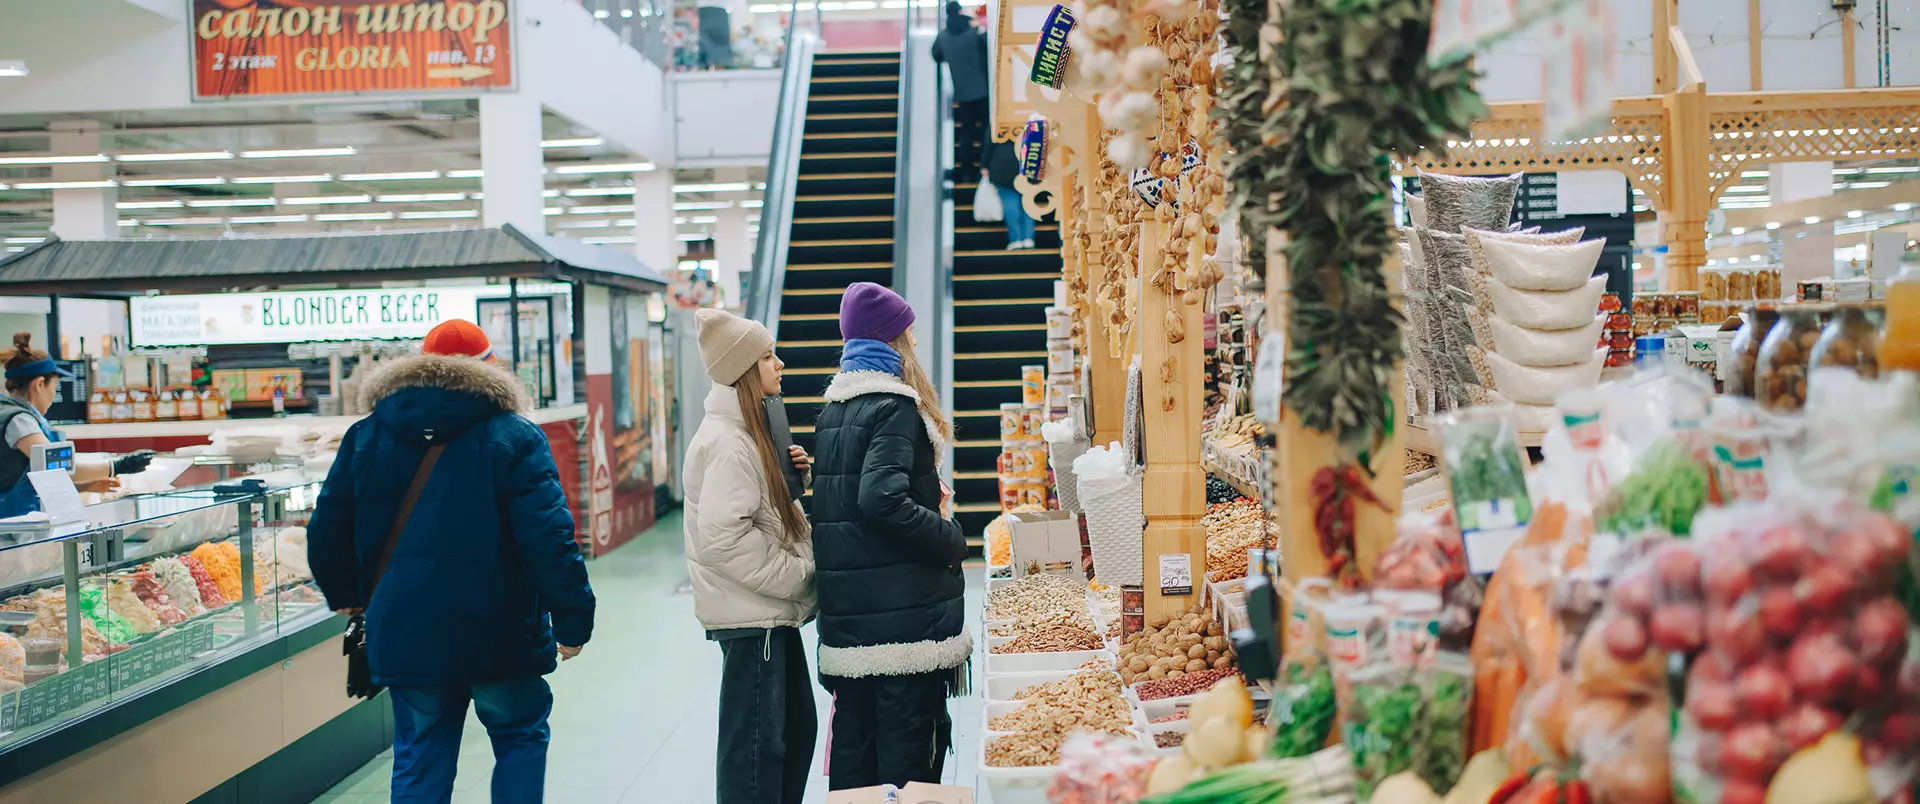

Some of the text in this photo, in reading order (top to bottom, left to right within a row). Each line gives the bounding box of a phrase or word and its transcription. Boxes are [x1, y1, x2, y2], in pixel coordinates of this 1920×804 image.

[198, 0, 508, 44] салон штор
[212, 52, 278, 71] 2 этаж
[295, 45, 411, 71] GLORIA
[427, 45, 496, 66] пав. 13
[262, 293, 440, 326] BLONDER BEER
